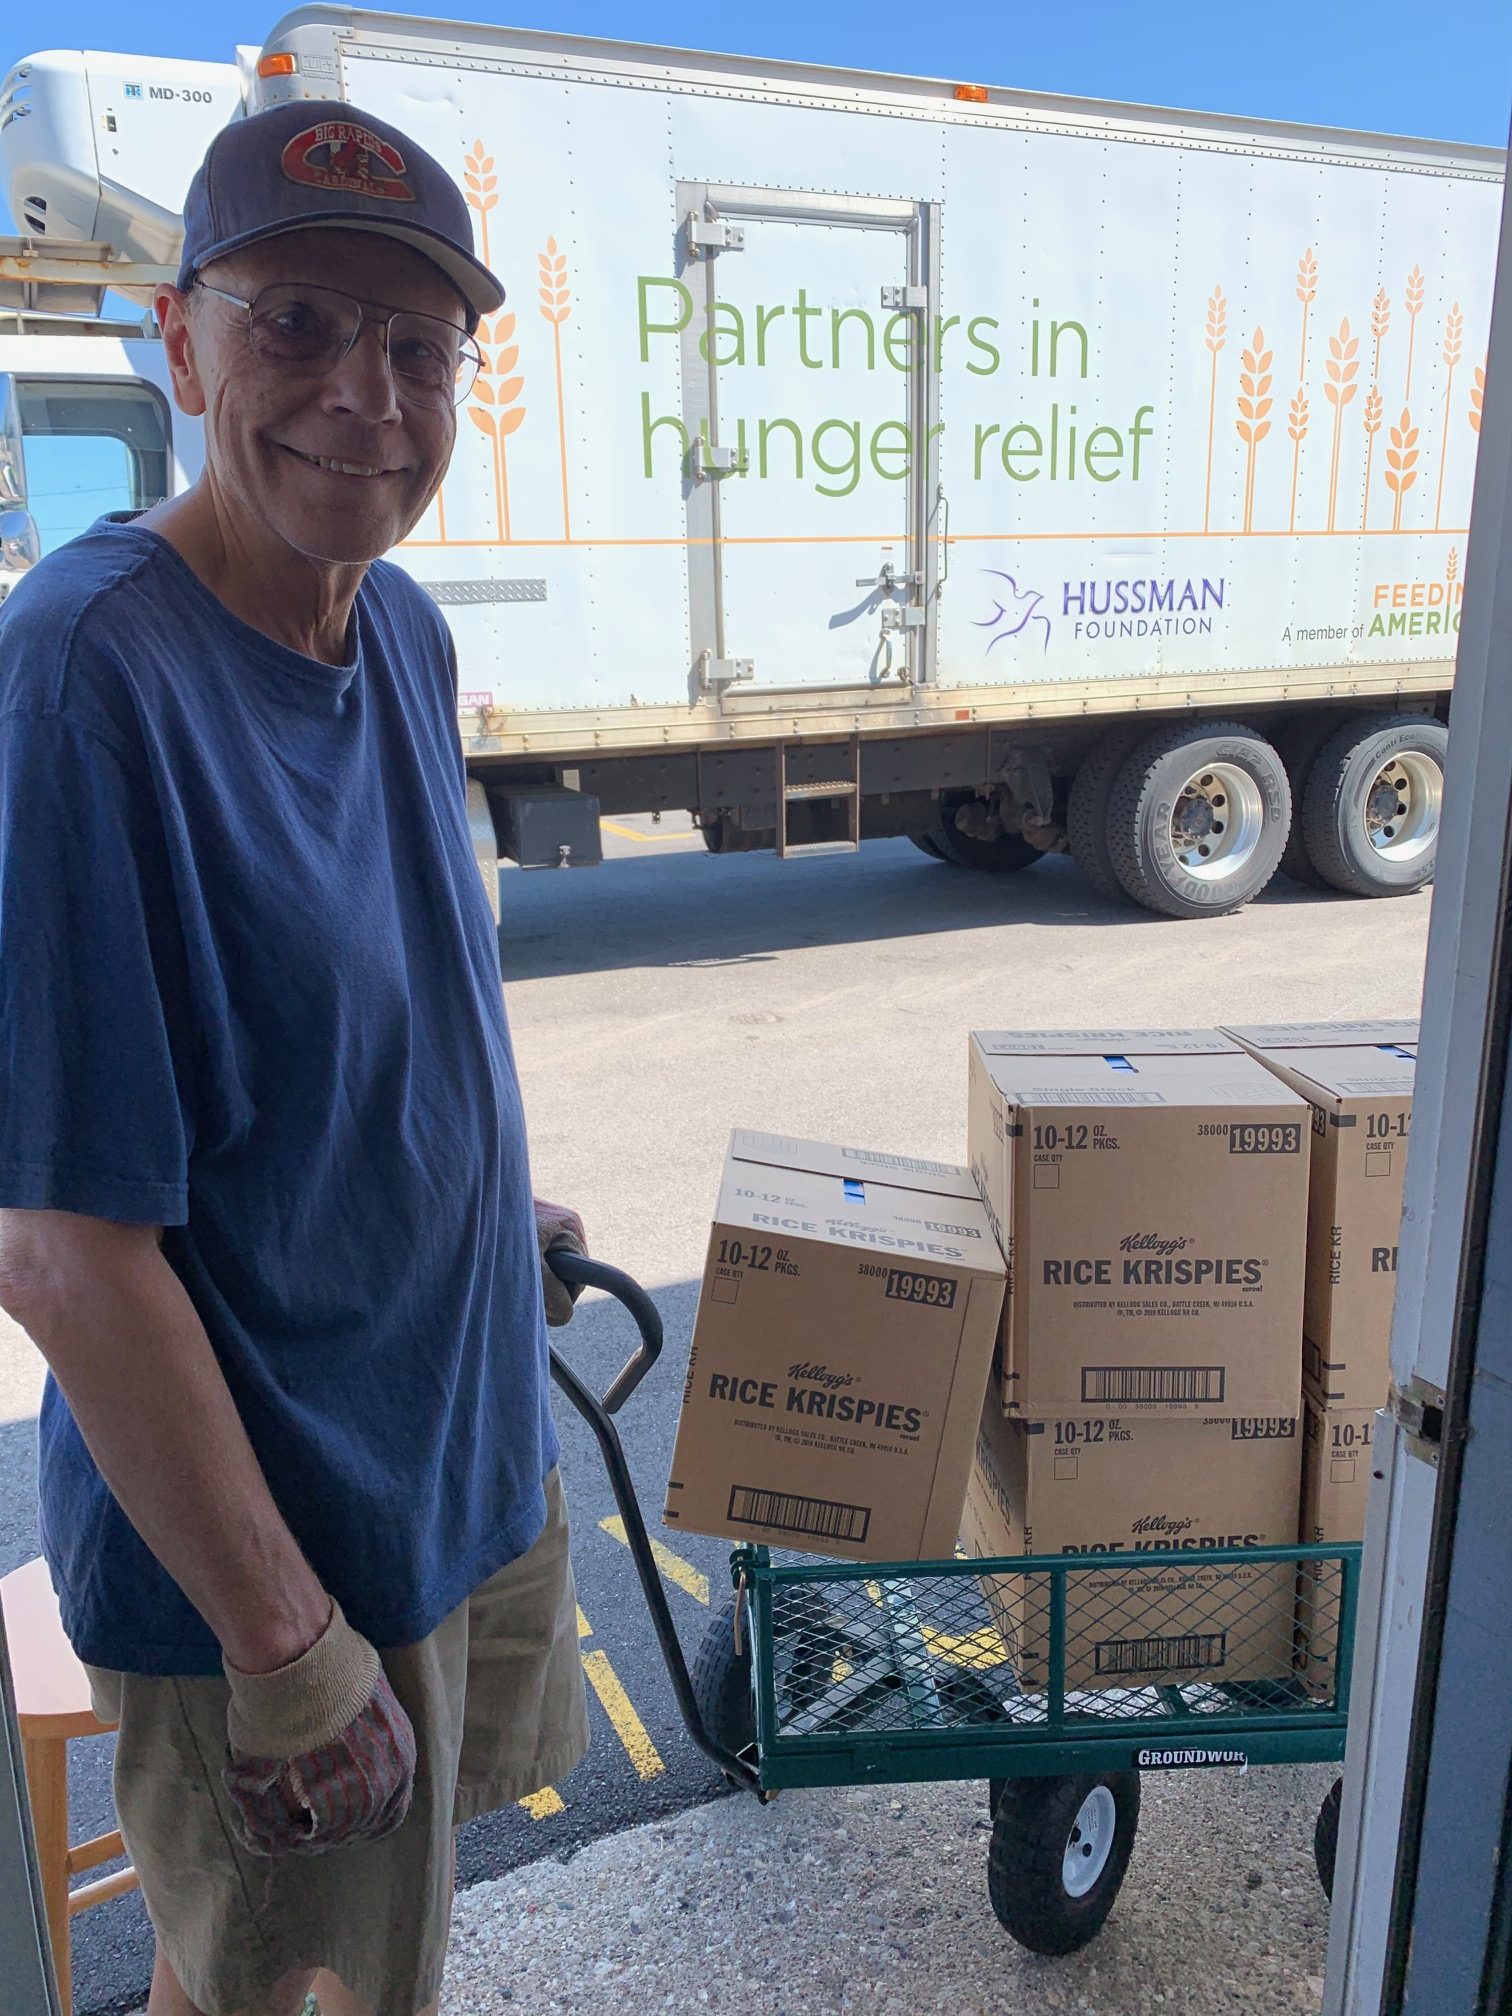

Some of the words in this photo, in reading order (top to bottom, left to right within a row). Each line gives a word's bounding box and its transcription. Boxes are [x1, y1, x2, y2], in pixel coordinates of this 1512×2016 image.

[149, 86, 212, 104] MD-300
[314, 125, 337, 142] BIG
[338, 125, 382, 153] RAPIDS
[636, 276, 1000, 376] Partners
[1031, 298, 1089, 378] in
[641, 391, 946, 497] hunger
[973, 403, 1154, 482] relief
[1062, 577, 1225, 615] HUSSMAN
[1074, 617, 1212, 639] FOUNDATION
[1282, 627, 1292, 641] A
[1297, 625, 1348, 641] member
[1351, 624, 1364, 639] of
[1366, 1112, 1411, 1138] 10-1
[1034, 1125, 1088, 1150] 10-12
[1093, 1125, 1107, 1137] OZ.
[1093, 1138, 1120, 1150] PKGS.
[1198, 1124, 1228, 1136] 38000
[1232, 1127, 1297, 1152] 19993
[1366, 1142, 1381, 1150] CASE
[1383, 1142, 1394, 1150] QTY
[1034, 1154, 1049, 1162] CASE
[1051, 1154, 1063, 1162] QTY
[734, 1188, 781, 1204] 10-12
[752, 1212, 819, 1233] RICE
[828, 1227, 964, 1259] KRISPIES
[927, 1222, 979, 1238] 19993
[715, 1239, 773, 1270] 10-12
[1119, 1232, 1187, 1255] Kellogg's
[733, 1269, 744, 1279] QTY
[774, 1261, 801, 1277] PKGS.
[1043, 1259, 1112, 1285] RICE
[1123, 1258, 1263, 1285] KRISPIES
[1329, 1251, 1341, 1284] RICE
[857, 1263, 888, 1279] 38000
[887, 1270, 953, 1306] 19993
[787, 1362, 855, 1389] Kellogg's
[708, 1373, 779, 1408] RICE
[786, 1387, 922, 1433] KRISPIES
[1054, 1420, 1104, 1444] 10-12
[1109, 1430, 1134, 1441] PKGS.
[1234, 1418, 1292, 1438] 19993
[1332, 1422, 1374, 1446] 10-1
[1070, 1447, 1081, 1455] QTY
[1131, 1514, 1192, 1536] Kellogg's
